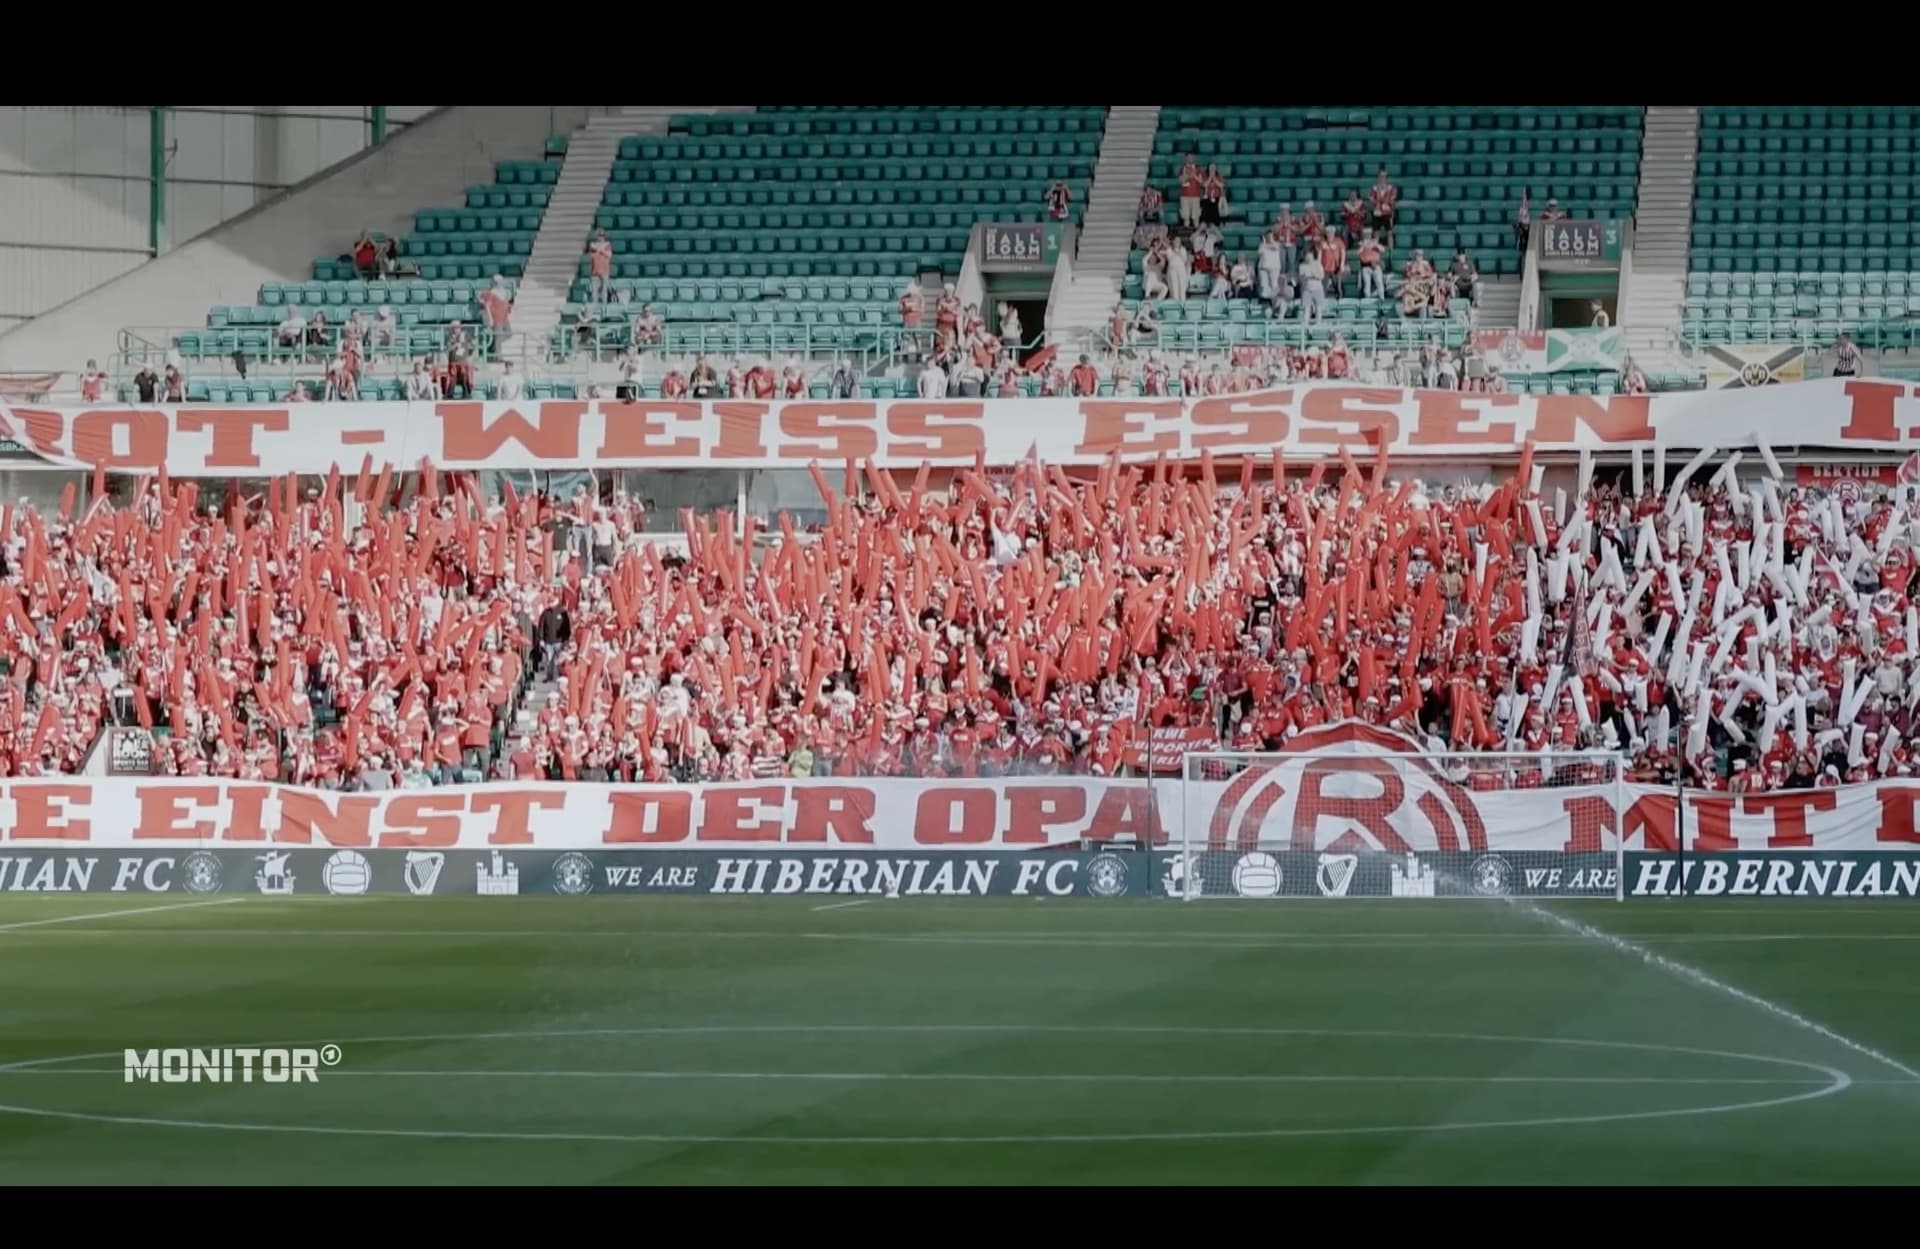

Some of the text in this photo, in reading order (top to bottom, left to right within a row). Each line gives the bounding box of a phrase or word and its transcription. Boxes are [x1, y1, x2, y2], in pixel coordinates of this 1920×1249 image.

[1047, 235, 1057, 250] 1
[1606, 230, 1616, 245] 3
[435, 402, 984, 460] WEISS
[1074, 387, 1656, 455] ESSEN
[132, 785, 567, 848] EINST
[602, 786, 876, 843] DER
[914, 786, 1169, 845] OPA
[1563, 790, 1836, 852] MIT
[111, 858, 175, 892] FC
[605, 866, 642, 886] WE
[648, 866, 698, 886] ARE
[709, 858, 999, 896] HIBERNIAN
[1011, 859, 1079, 896] FC
[1524, 867, 1562, 889] WE
[1567, 867, 1617, 889] ARE
